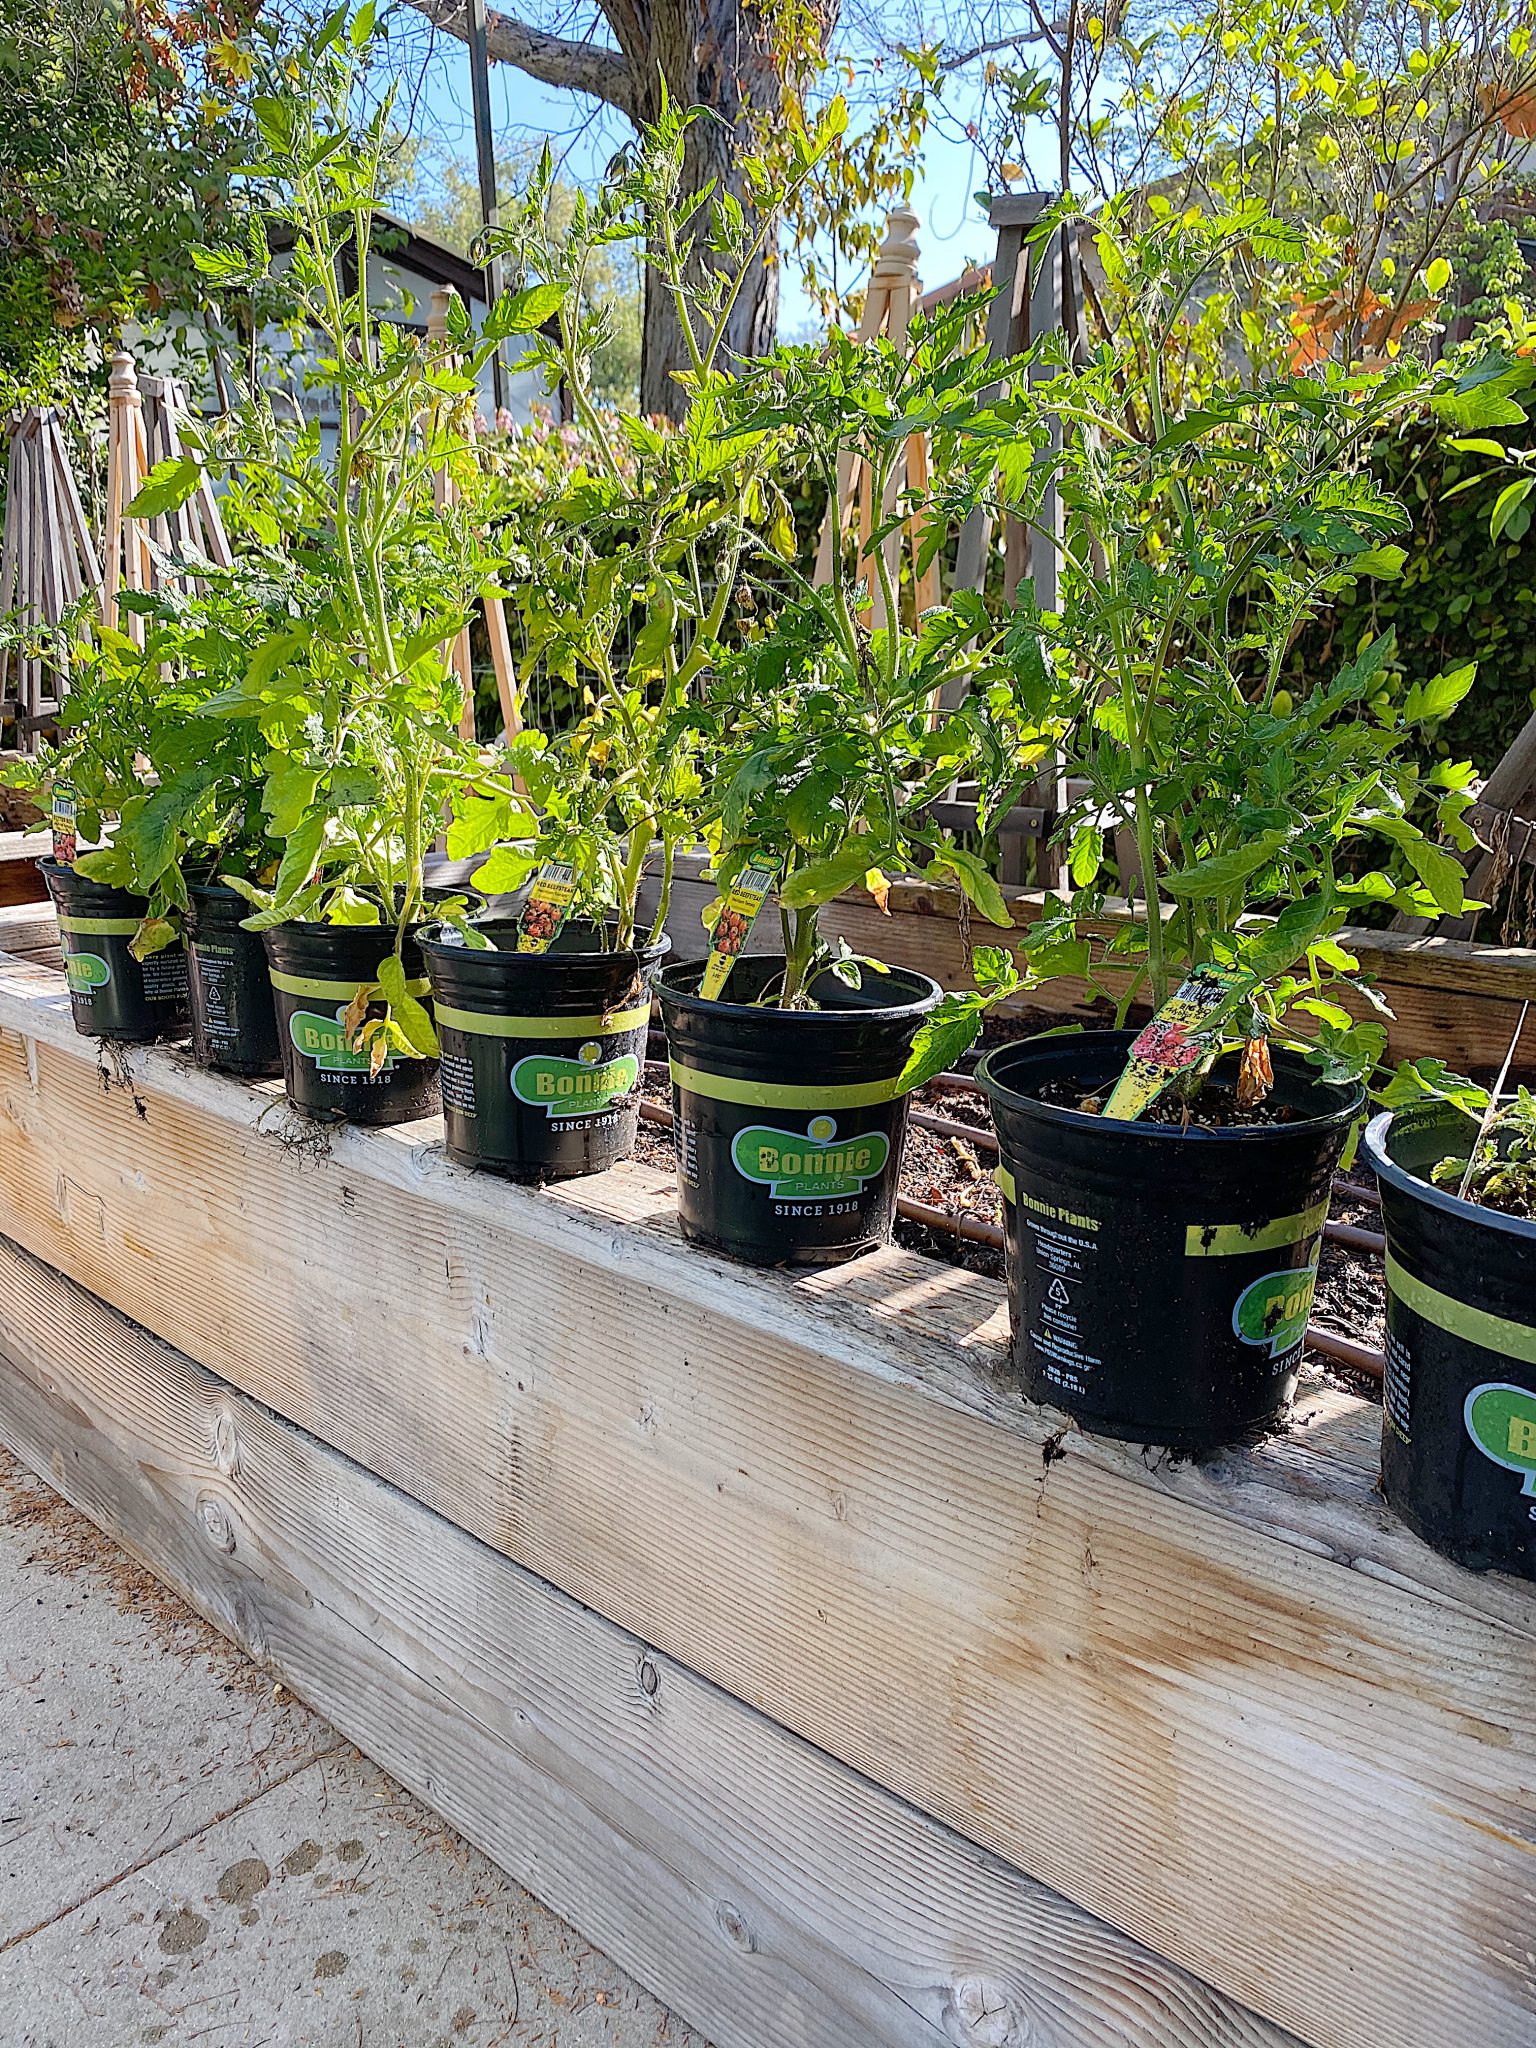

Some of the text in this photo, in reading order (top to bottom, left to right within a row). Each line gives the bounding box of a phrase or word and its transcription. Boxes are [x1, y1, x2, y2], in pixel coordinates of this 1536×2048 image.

[304, 1027, 398, 1052] Bone
[320, 1073, 392, 1086] SINCE 1918
[536, 1067, 627, 1097] Bonnie
[551, 1112, 619, 1133] SINCE 1918
[758, 1146, 872, 1176] Bonnie
[795, 1180, 845, 1192] PLANTS
[774, 1200, 859, 1217] SINCE 1918
[1022, 1191, 1099, 1232] Bonnie Plants
[1037, 1239, 1072, 1259] Headquarters
[1055, 1287, 1061, 1297] 5
